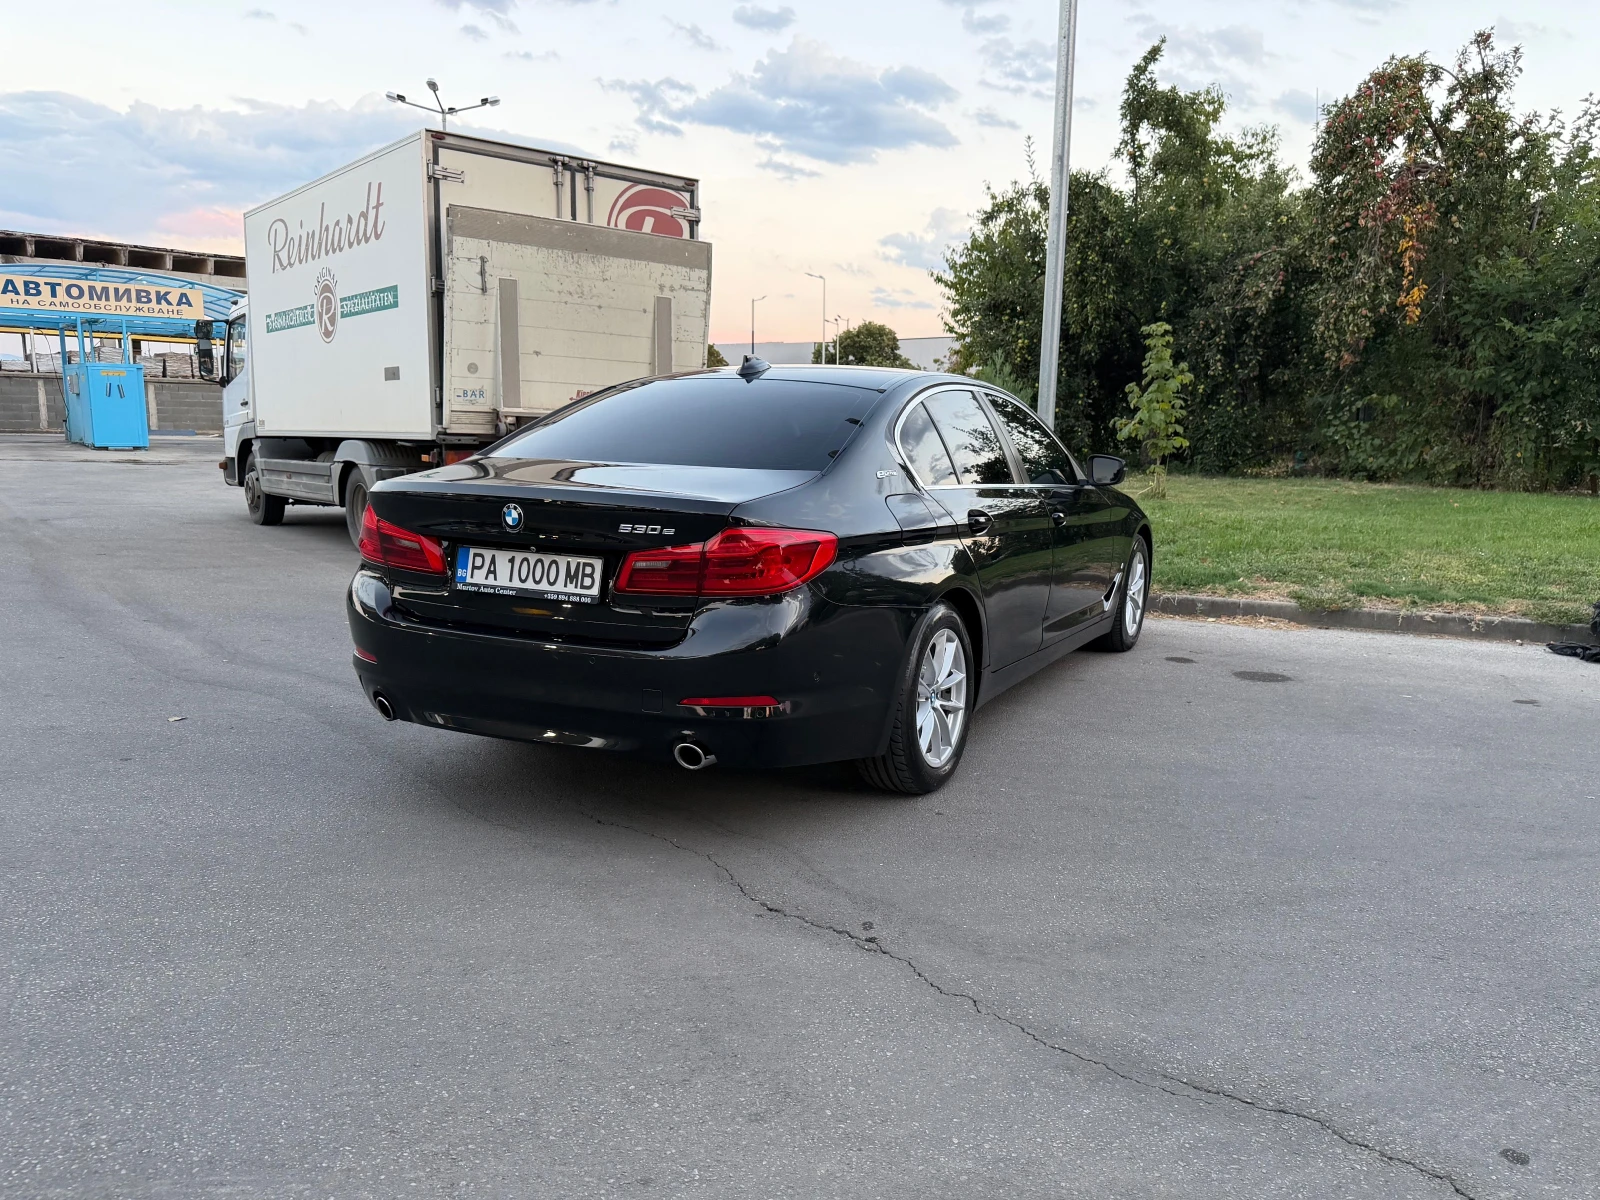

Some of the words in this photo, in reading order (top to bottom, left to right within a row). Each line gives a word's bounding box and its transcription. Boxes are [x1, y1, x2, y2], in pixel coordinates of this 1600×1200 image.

[268, 181, 386, 274] Reinhardt
[1, 278, 193, 308] АВТОМИВКА
[343, 290, 394, 314] SPEZIALITÄTEN
[10, 298, 31, 306] НА
[37, 299, 184, 316] САМООБСЛУЖВАНЕ
[319, 292, 335, 333] R
[457, 568, 467, 577] BG
[470, 552, 498, 581] PA
[507, 555, 560, 586] 1000
[563, 560, 596, 590] MB
[479, 586, 494, 594] Auto
[495, 587, 517, 596] Center
